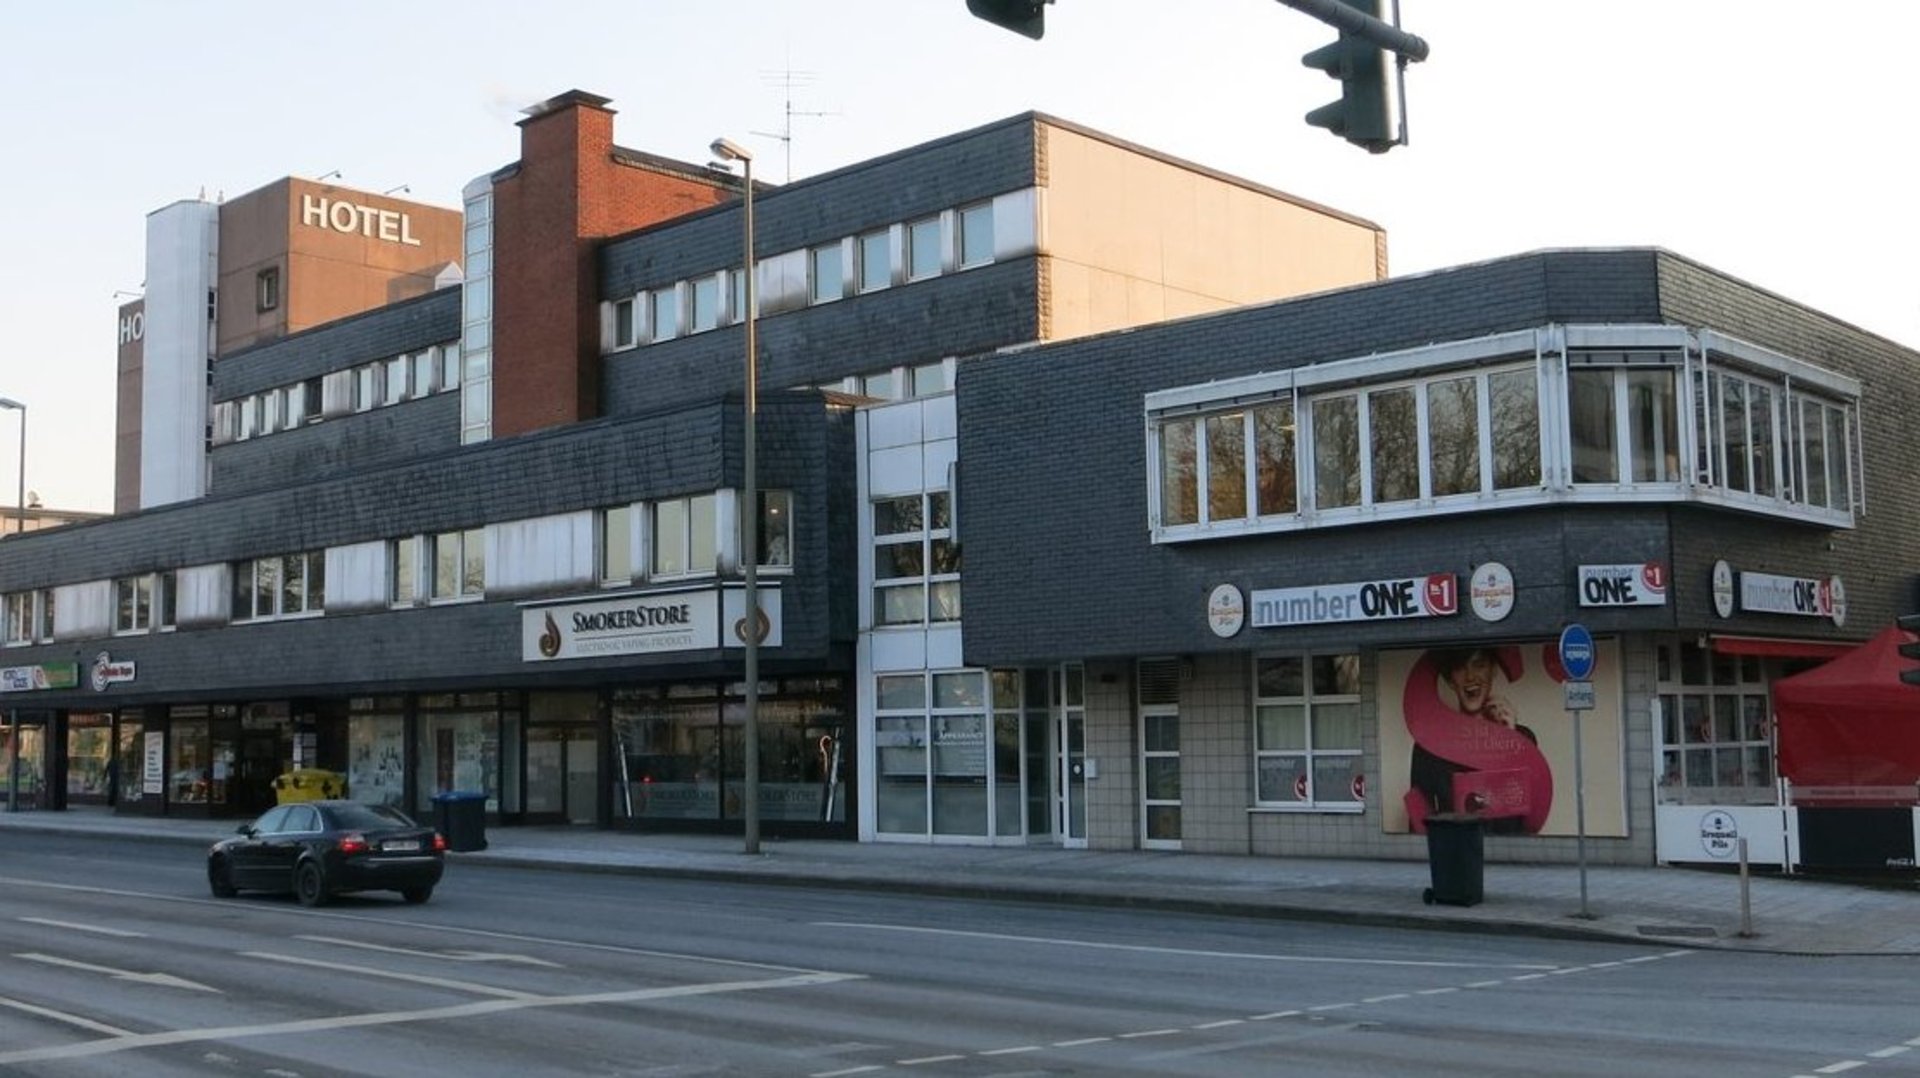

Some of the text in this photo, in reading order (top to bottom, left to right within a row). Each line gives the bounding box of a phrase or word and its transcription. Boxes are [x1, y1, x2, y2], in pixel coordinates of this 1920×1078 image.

[302, 194, 420, 246] HOTEL
[1583, 566, 1634, 577] number
[1584, 575, 1638, 603] ONE
[1255, 590, 1357, 625] number
[1360, 580, 1419, 617] ONE
[1793, 578, 1818, 613] ONE
